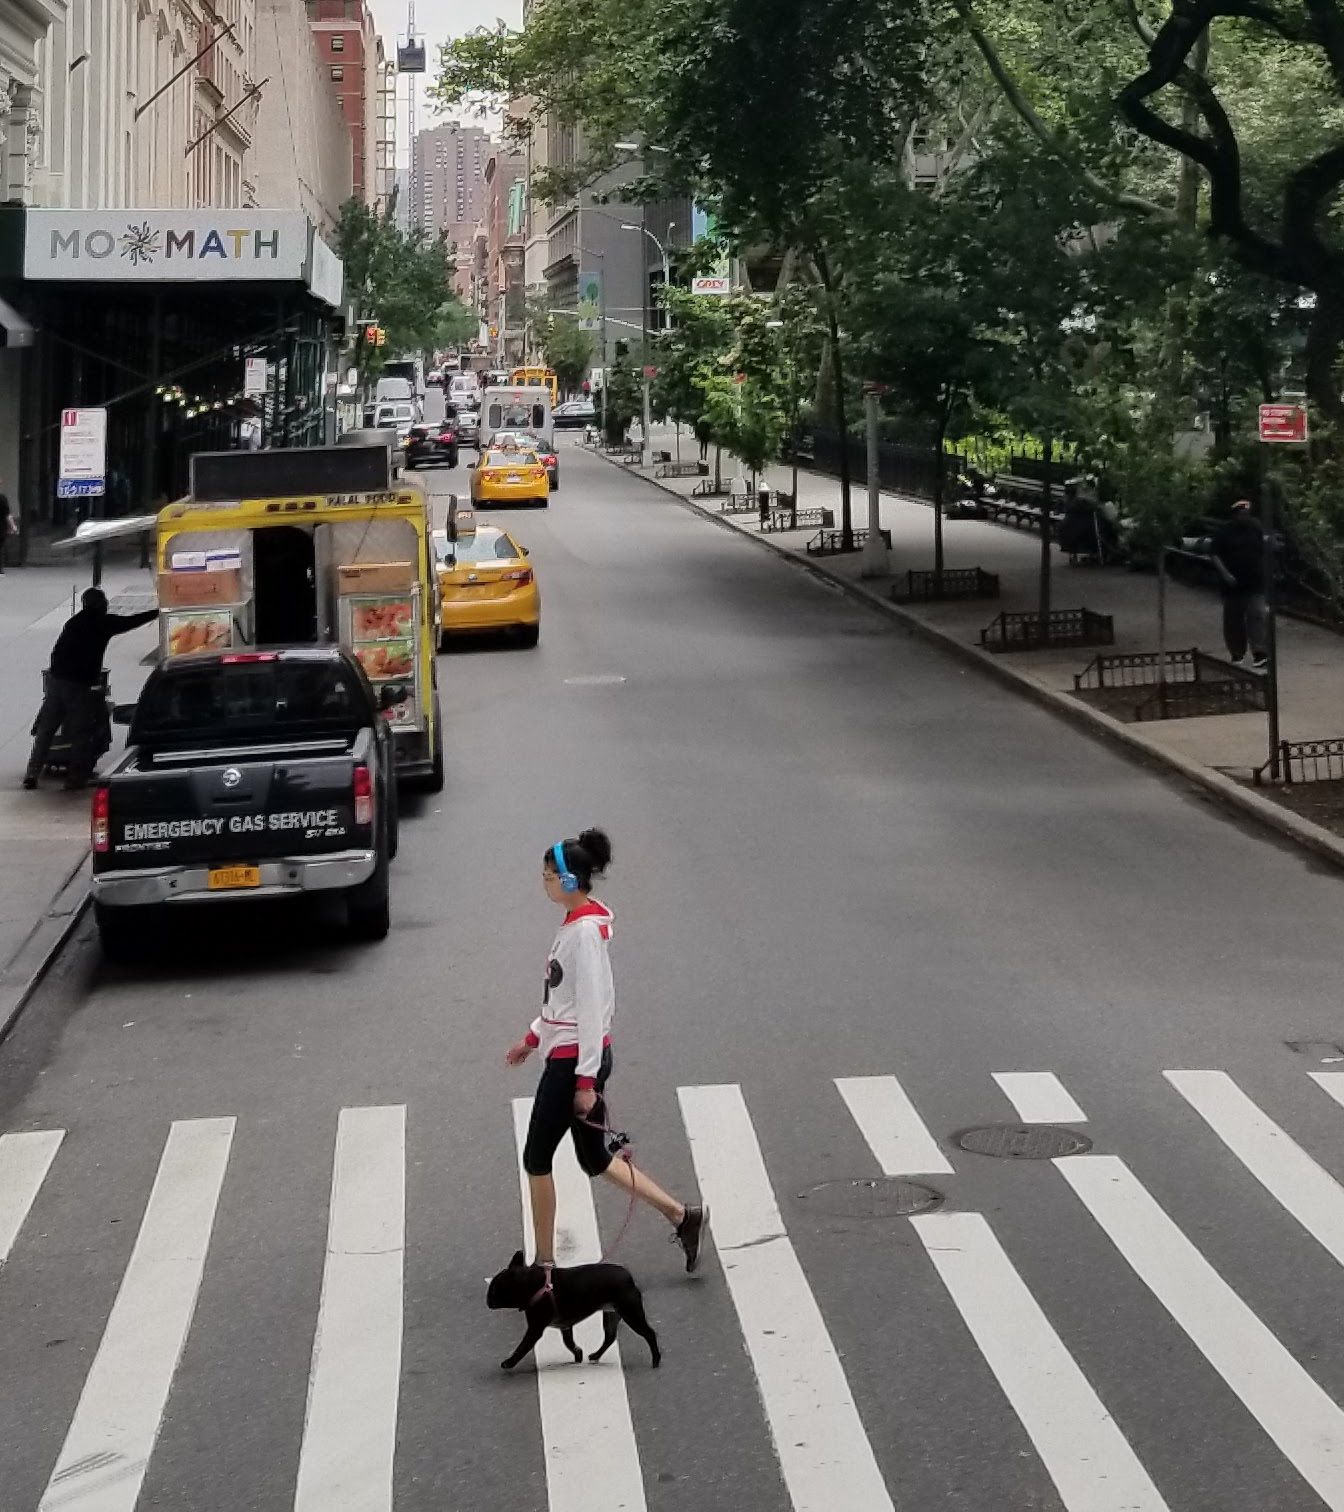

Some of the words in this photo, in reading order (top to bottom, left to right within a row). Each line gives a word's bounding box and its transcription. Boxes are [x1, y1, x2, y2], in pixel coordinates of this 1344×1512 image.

[50, 229, 116, 259] MO
[164, 229, 280, 259] MATH
[124, 817, 225, 841] EMERGENCY
[228, 814, 265, 833] GAS
[268, 809, 339, 831] SERVICE
